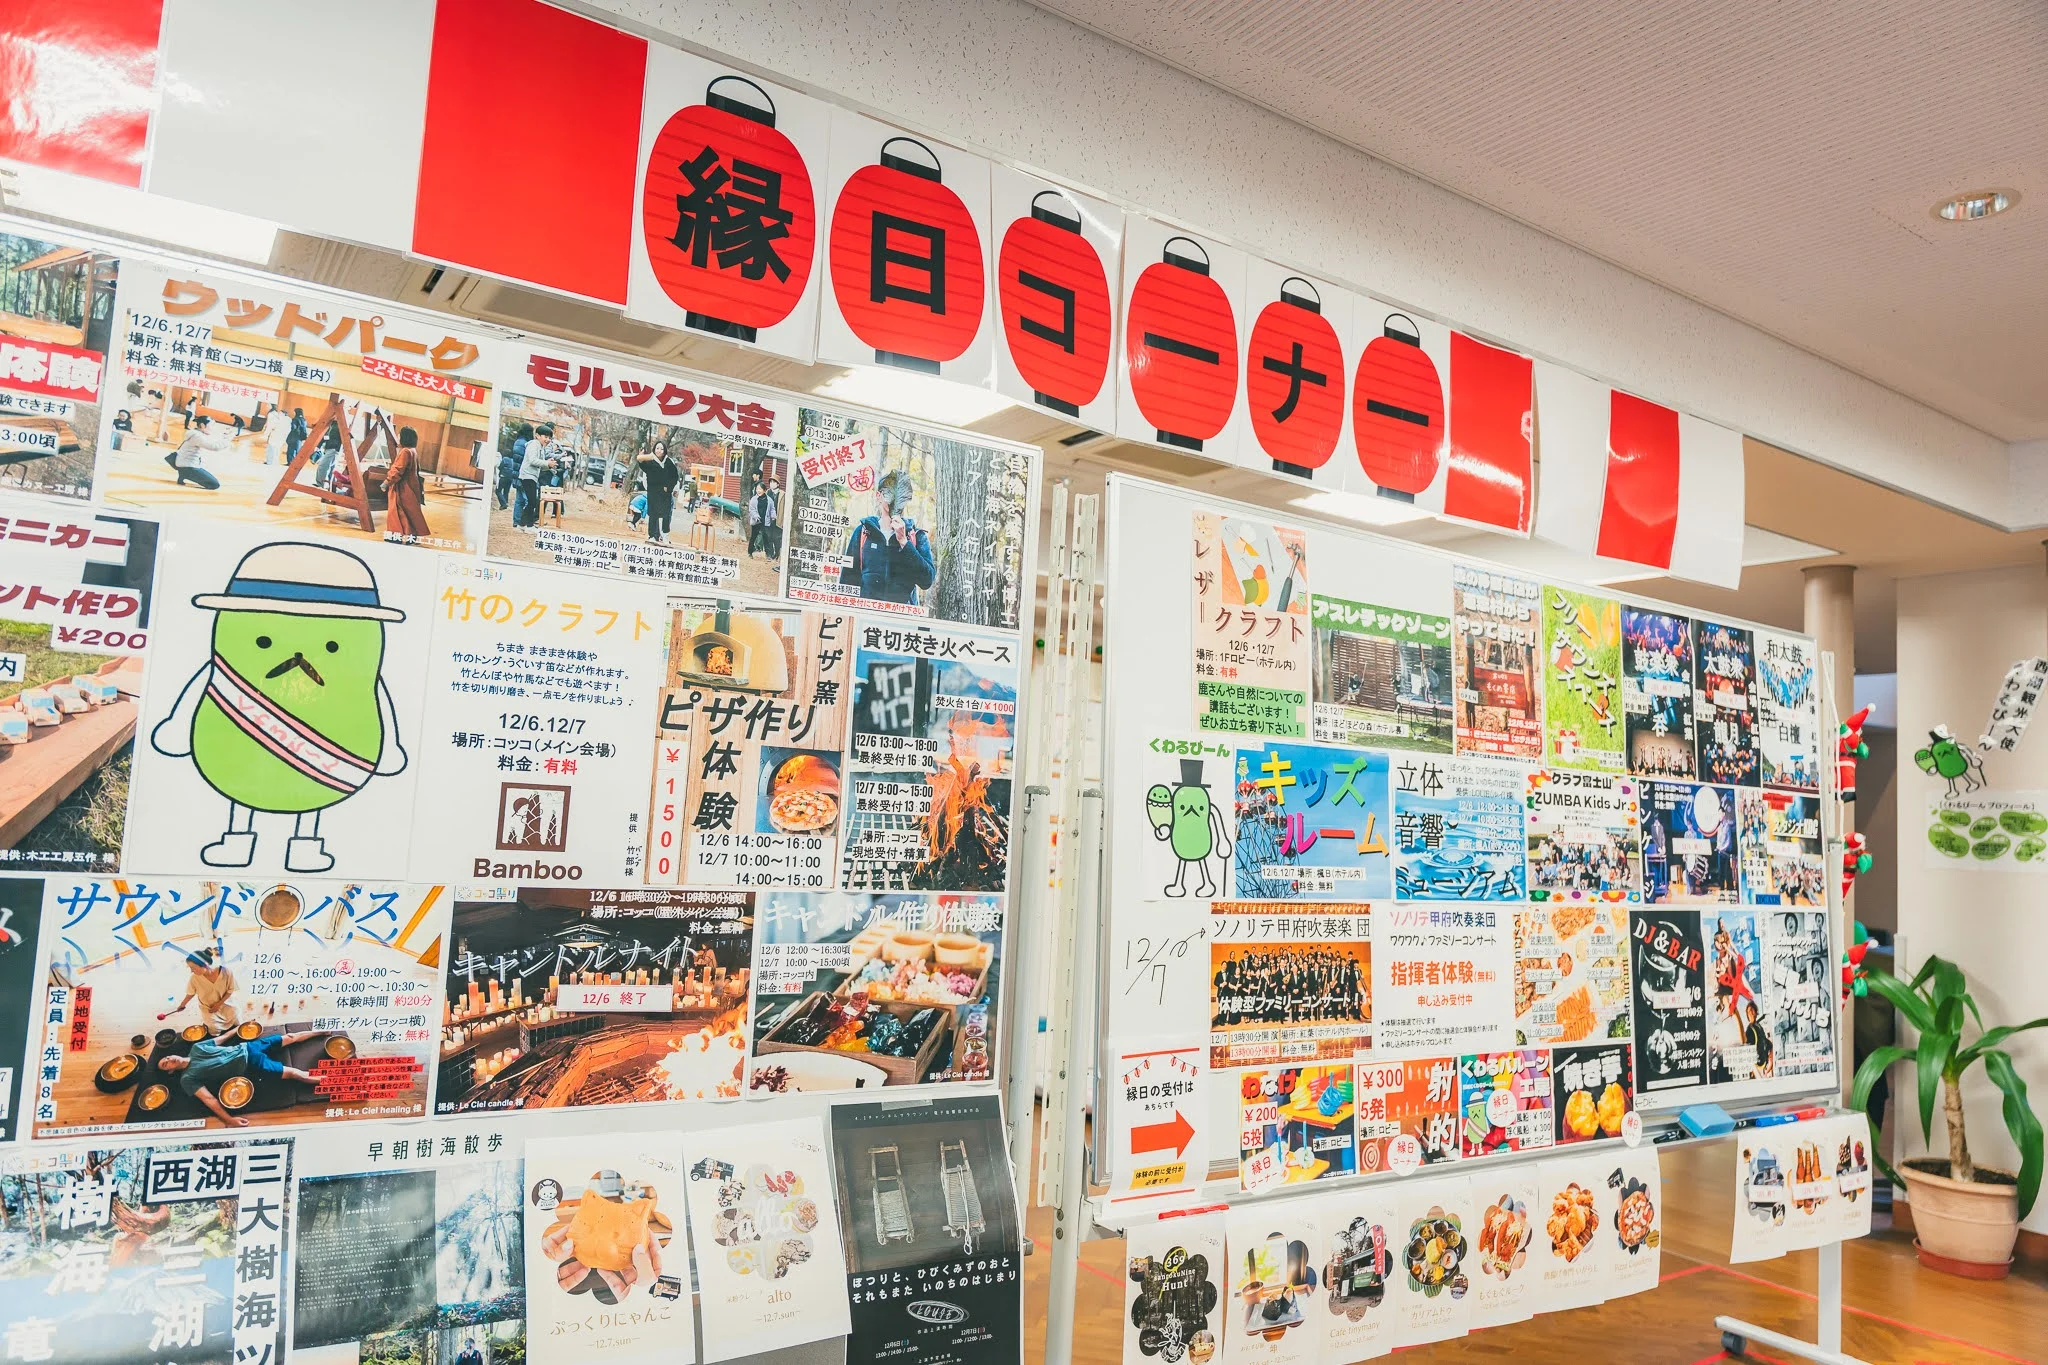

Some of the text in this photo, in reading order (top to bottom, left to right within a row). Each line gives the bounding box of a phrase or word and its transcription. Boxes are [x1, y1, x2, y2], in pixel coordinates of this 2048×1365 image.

[131, 313, 213, 340] 12/6.12/7
[162, 278, 480, 370] ウッドパーク
[126, 348, 202, 376] 料金：無料
[127, 331, 284, 375] 場所：体育館（コッコ横
[0, 342, 102, 393] 体験
[124, 366, 271, 401] 有料クラフト体験もあります！
[361, 357, 477, 400] こどもにも大人気！
[526, 354, 777, 438] モルック大会
[822, 418, 840, 429] 12/6
[801, 438, 867, 480] 受付終了
[810, 497, 828, 509] 12/7
[803, 524, 843, 539] 12:00戻り
[534, 541, 618, 561] 晴天時：モルック広場
[790, 548, 852, 565] 集合場所：ロビー
[554, 554, 719, 587] 受付場所：ロビー 集合場所：体育館前広場
[699, 554, 738, 569] 料金：無料
[801, 561, 841, 577] 料金：無料
[1193, 539, 1214, 624] レザー
[789, 589, 925, 615] ご希望の方は総合受付にてお声がけ下さい
[440, 585, 653, 641] 竹のクラフト
[1311, 599, 1451, 640] アスレチックゾーン
[1215, 607, 1305, 643] クラフト
[496, 642, 598, 662] ちまき まきまき体験や
[862, 626, 1012, 664] 貸切焚き火ベース
[1766, 639, 1803, 664] 和太鼓
[813, 616, 843, 706] ピザ窯
[1196, 663, 1239, 678] 料金：有料
[460, 667, 620, 692] 竹とんぼや竹馬などでも遊べます！
[1197, 682, 1303, 705] 鹿さんや自然についての
[659, 690, 817, 743] ピザ作り
[1209, 699, 1290, 719] 講話もございます！
[498, 713, 587, 735] 12/6.12/7
[1200, 715, 1301, 735] ぜひお立ち寄り下さい！
[451, 732, 617, 758] 場所：コッコ（メイン会場）
[856, 733, 938, 752] 12/6 13:00～18:00
[1149, 737, 1231, 758] くわるびーん
[497, 754, 578, 776] 料金：有料
[858, 751, 934, 767] 最終受付16:30
[691, 740, 742, 831] 体験
[1258, 750, 1368, 808] キッズ
[1396, 761, 1444, 797] 立体
[855, 781, 933, 798] 12/7 9:00～15:00
[856, 798, 931, 813] 最終受付13:30
[1534, 791, 1631, 811] ZUMBA Kids Jr.
[862, 830, 919, 844] 場所：コッコ
[1279, 811, 1390, 858] ルーム
[1395, 811, 1444, 850] 音響
[699, 833, 822, 850] 12/6 14:00～16:00
[698, 852, 821, 868] 12/7 10:00～11:00
[852, 845, 927, 861] 現地受付・精算
[473, 857, 583, 881] Bamboo
[735, 872, 823, 887] 14:00～15:00
[1396, 865, 1524, 901] ミュージアム
[57, 882, 255, 930] サウンド
[303, 885, 401, 924] バス
[589, 891, 617, 902] 12/6
[689, 922, 744, 934] 料金：無料
[1213, 917, 1371, 939] ソノリテ甲府吹奏楽団
[1389, 910, 1497, 929] ソノリテ甲府吹奏楽団
[253, 953, 282, 964] 12/6
[760, 945, 781, 955] 12/6
[452, 936, 698, 985] キャンドルナイト
[760, 958, 780, 968] 12/7
[758, 970, 815, 981] 場所：コッコ内
[1125, 937, 1170, 1006] 12/7
[251, 984, 279, 995] 12/7
[757, 982, 802, 994] 料金：有料
[336, 994, 433, 1009] 体験時間 約20分
[582, 991, 648, 1006] 12/6 終了
[1417, 994, 1474, 1008] 申し込み受付中
[70, 989, 91, 1050] 現地受付
[370, 1028, 430, 1043] 料金：無料
[1211, 1034, 1228, 1044] 12/7
[1230, 1030, 1279, 1044] 13時30分開演
[1282, 1043, 1316, 1056] 料金：無料
[1461, 1054, 1550, 1079] くわるバルーン
[1563, 1054, 1623, 1093] 焼き芋
[1241, 1070, 1298, 1099] わなげ
[1362, 1068, 1403, 1090] ¥300
[1519, 1077, 1550, 1099] 工房
[1126, 1080, 1195, 1102] 縁日の受付は
[1492, 1093, 1509, 1107] 縁日
[380, 1104, 411, 1115] healing
[487, 1098, 514, 1107] candle
[1144, 1100, 1175, 1112] あちらです
[1360, 1098, 1385, 1121] 5発
[1425, 1062, 1457, 1154] 射的
[1244, 1105, 1278, 1123] ¥200
[1242, 1127, 1263, 1147] 5投
[1360, 1124, 1400, 1138] 場所：ロビー
[367, 1133, 504, 1162] 早朝樹海散歩
[1313, 1138, 1351, 1150] 場所：ロビー
[1396, 1140, 1415, 1154] 縁日
[151, 1154, 238, 1195] 西湖
[1135, 1165, 1184, 1180] 体験の前に受付が
[1250, 1156, 1272, 1174] 縁日
[917, 1258, 1010, 1279] ひびくみずのおと
[1166, 1255, 1185, 1268] 369
[852, 1271, 1017, 1304] それもまた いのちのはじまり
[1161, 1279, 1188, 1292] Hunt
[767, 1289, 793, 1304] alto
[550, 1306, 673, 1336] ぷっくりにゃんこ
